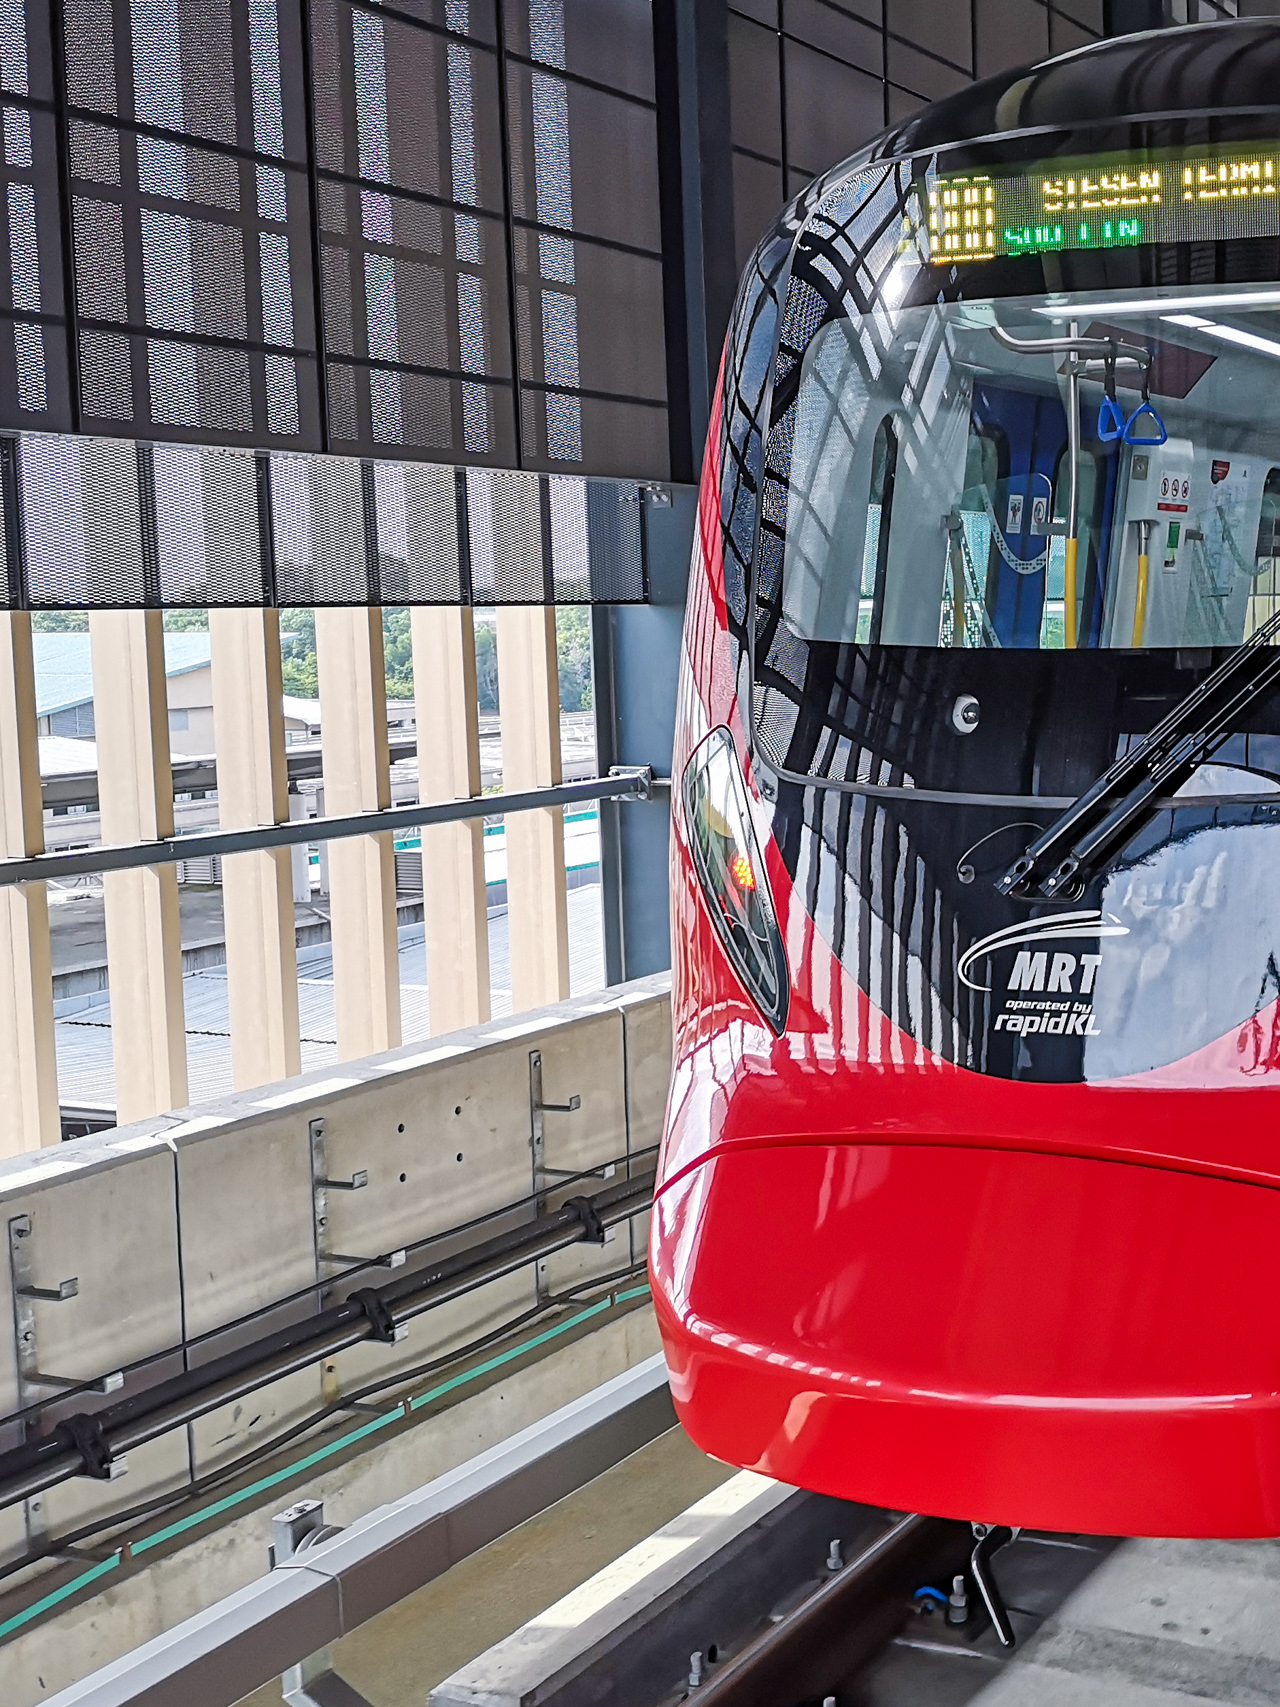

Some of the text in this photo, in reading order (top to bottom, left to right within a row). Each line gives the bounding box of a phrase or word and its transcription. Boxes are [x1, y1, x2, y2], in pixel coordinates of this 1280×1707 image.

[1006, 951, 1103, 994] MRT
[1005, 1000, 1093, 1014] operated by
[994, 1012, 1102, 1037] rapidKL
